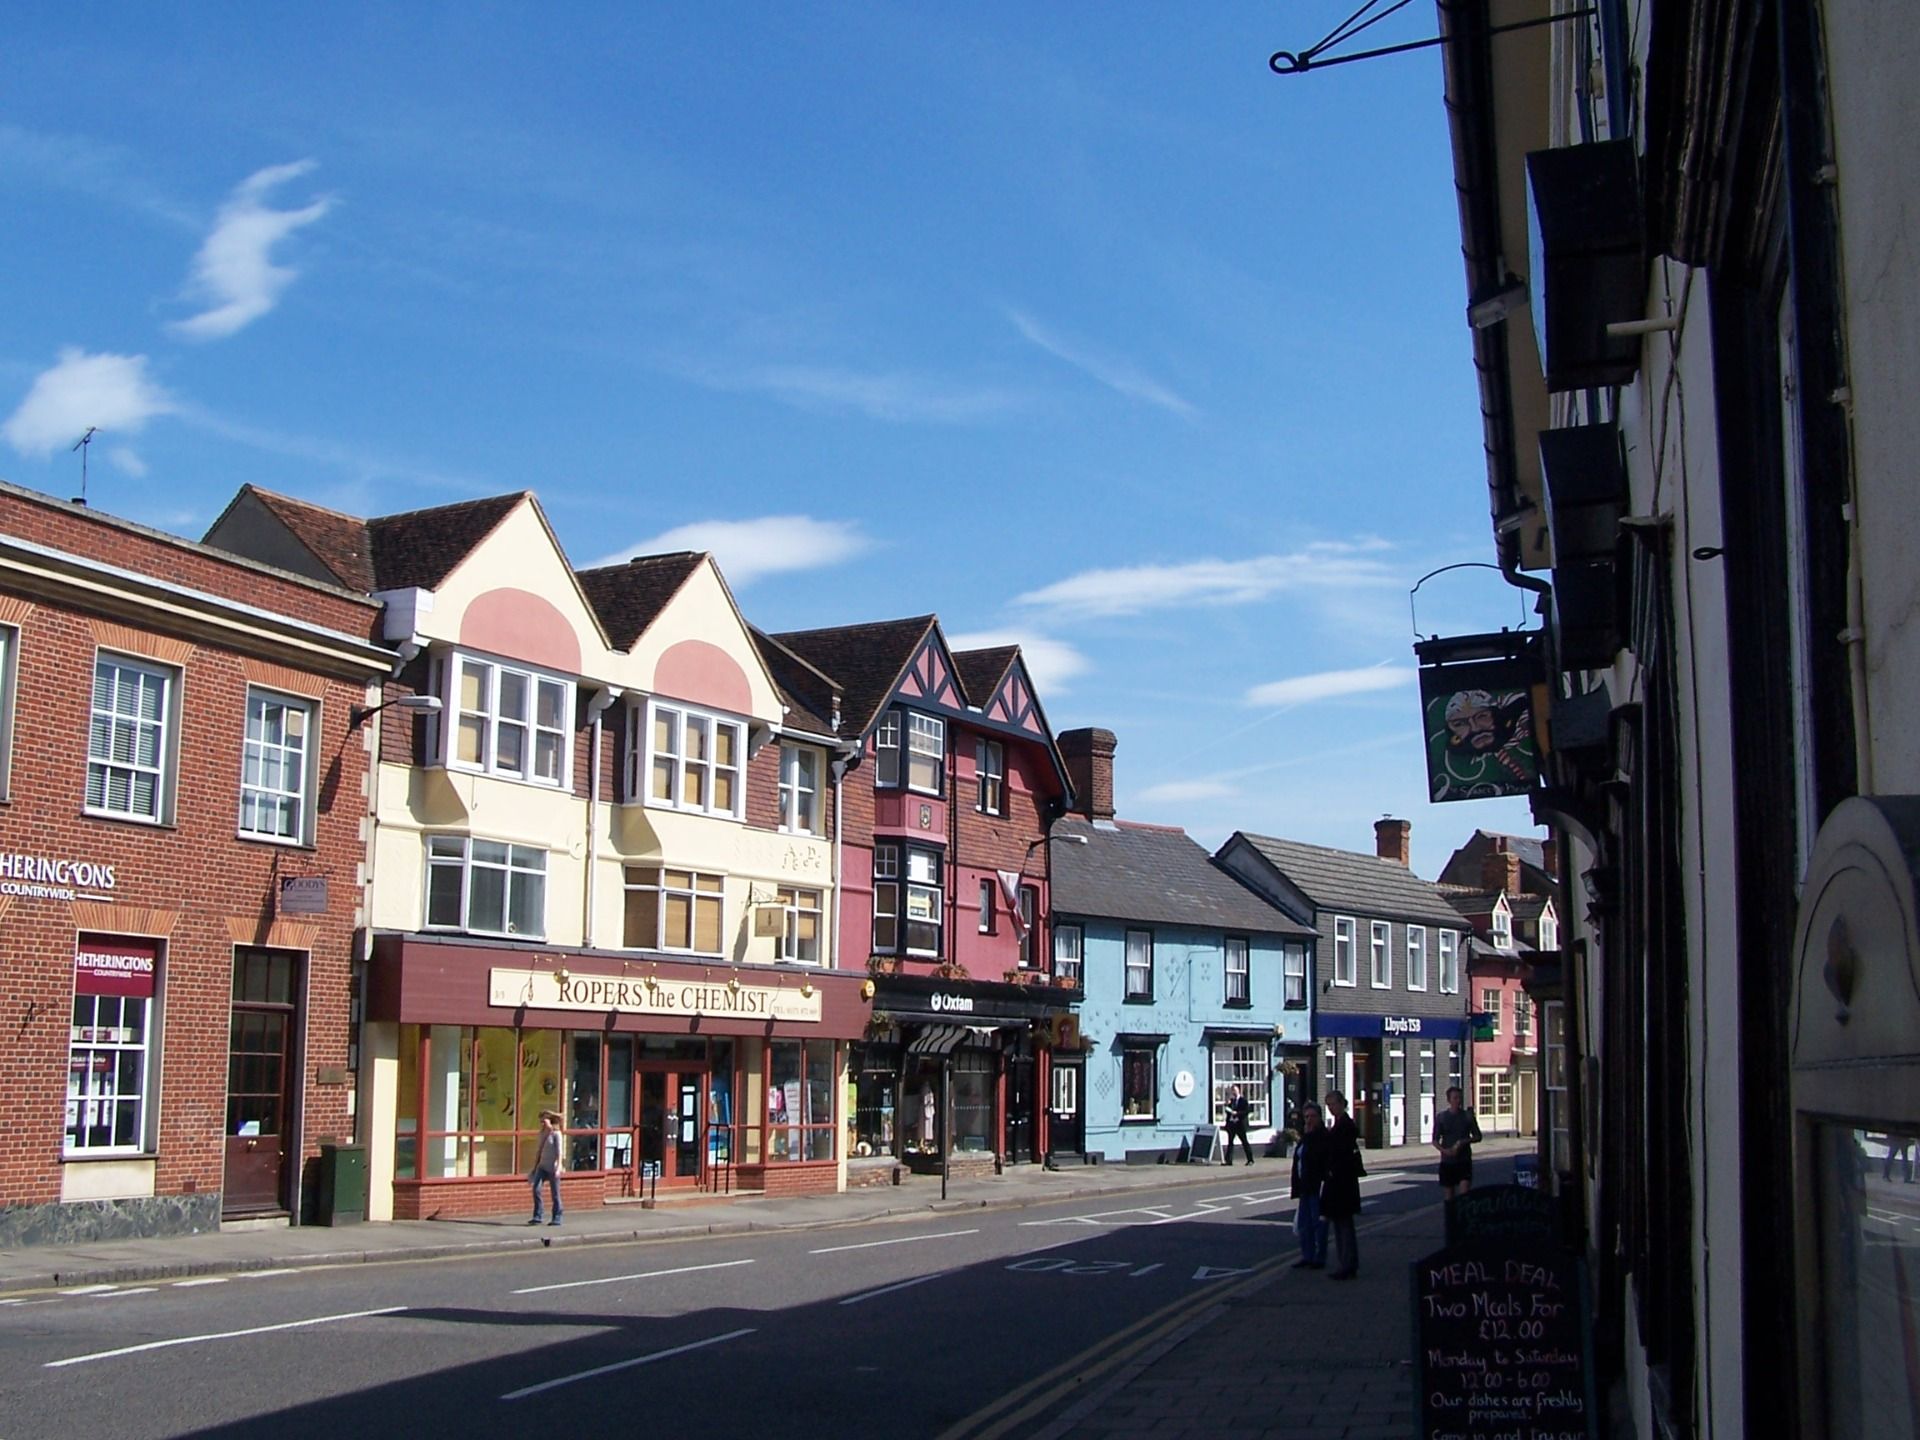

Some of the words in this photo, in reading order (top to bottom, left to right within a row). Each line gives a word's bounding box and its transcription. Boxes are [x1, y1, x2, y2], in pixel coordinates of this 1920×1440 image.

[1, 883, 76, 900] COUNTRYWIDE
[75, 952, 153, 972] HETHERINGTONS
[559, 980, 643, 1007] ROPERS
[649, 985, 675, 1008] the
[681, 987, 768, 1013] CHEMIST
[942, 993, 973, 1011] Oxfam
[1385, 1017, 1408, 1036] Lloyds
[1408, 1018, 1421, 1032] TSB
[1430, 1261, 1495, 1288] MEAL
[1504, 1260, 1560, 1290] DEAL
[1424, 1295, 1466, 1317] Two
[1471, 1291, 1521, 1317] Meals
[1529, 1294, 1564, 1317] For
[1479, 1320, 1544, 1340] £12.00
[1428, 1350, 1487, 1374] Monday
[1494, 1350, 1509, 1365] to
[1514, 1349, 1579, 1371] Saturday
[1431, 1391, 1463, 1408] Our
[1468, 1391, 1508, 1407] dishes
[1512, 1396, 1533, 1407] are
[1536, 1389, 1584, 1414] freshly
[1493, 1428, 1521, 1440] and
